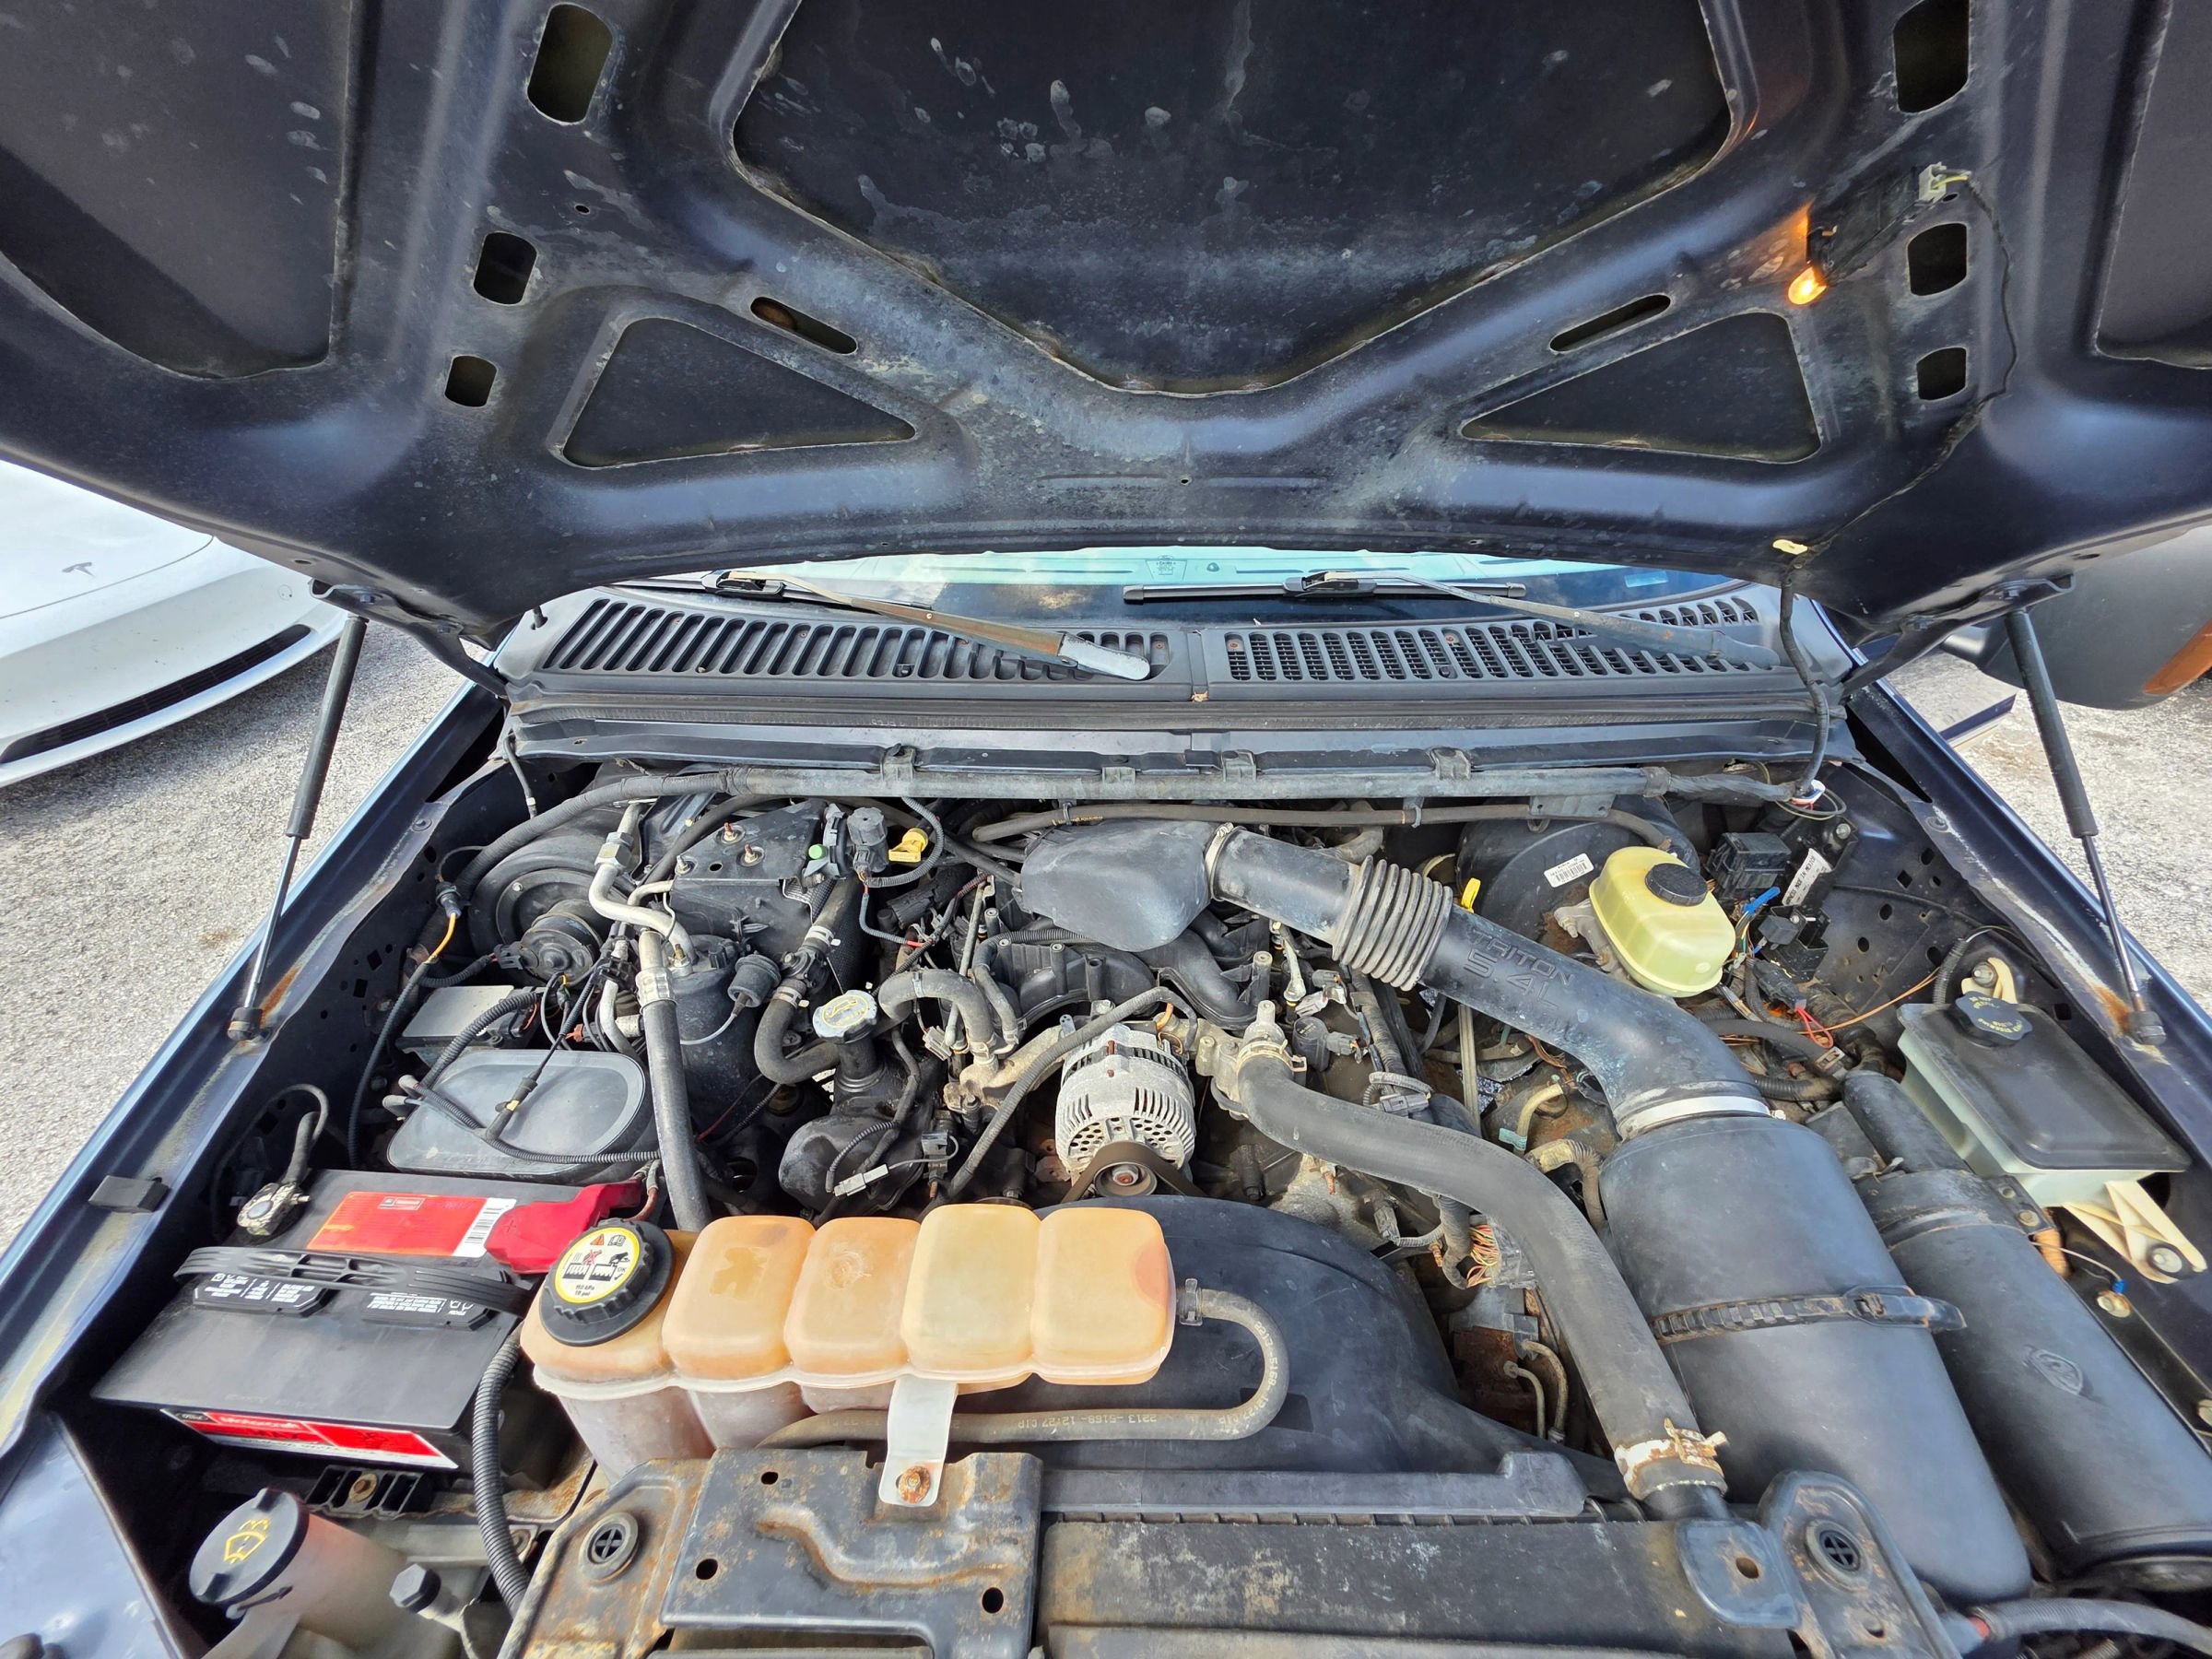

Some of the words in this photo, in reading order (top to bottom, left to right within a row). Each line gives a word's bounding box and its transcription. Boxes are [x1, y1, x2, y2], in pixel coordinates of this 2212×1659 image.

[1471, 928, 1576, 985] TRITON
[1462, 948, 1559, 1010] 5.4L
[1253, 1321, 1274, 1347] 2213
[1128, 1414, 1158, 1424] 2213
